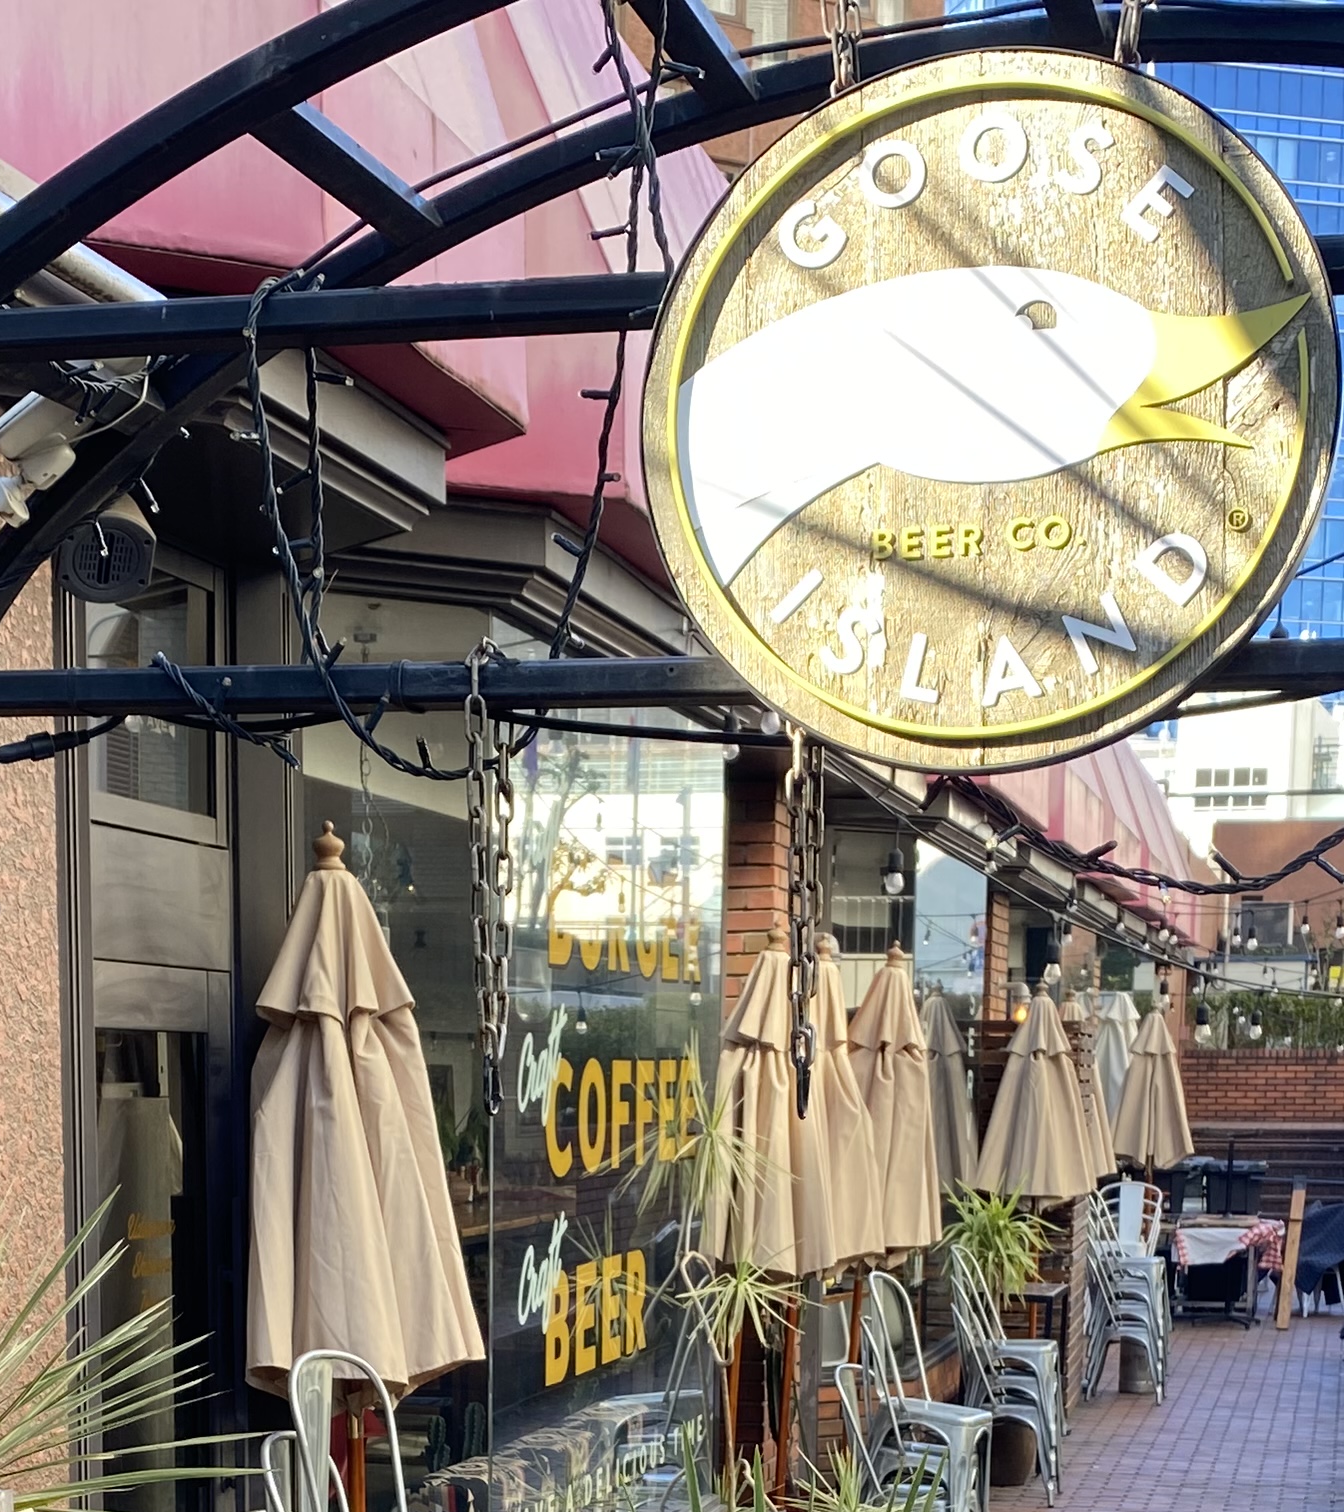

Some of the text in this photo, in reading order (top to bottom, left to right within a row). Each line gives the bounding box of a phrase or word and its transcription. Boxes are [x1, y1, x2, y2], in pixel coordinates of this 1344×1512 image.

[778, 113, 1196, 270] GOOSE
[871, 523, 984, 562] BEER
[770, 530, 1209, 707] ISLAND
[547, 852, 702, 985] BURGER
[517, 1003, 568, 1127] Craft
[545, 1057, 698, 1178] COFFEE
[518, 1211, 569, 1335] Craft
[545, 1249, 647, 1387] BEER
[583, 1434, 666, 1506] DELICIOUS
